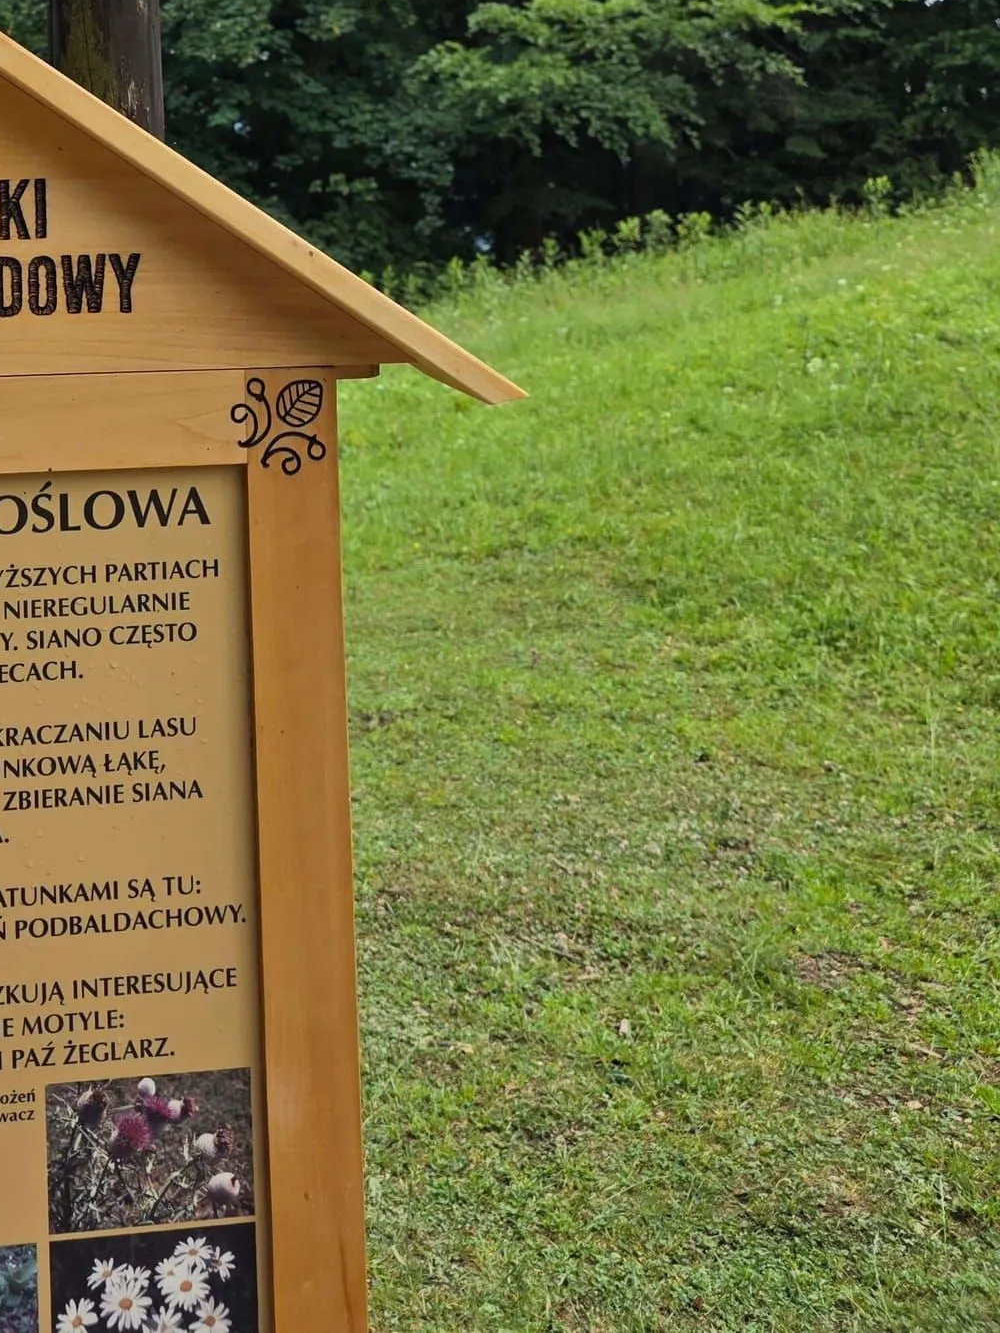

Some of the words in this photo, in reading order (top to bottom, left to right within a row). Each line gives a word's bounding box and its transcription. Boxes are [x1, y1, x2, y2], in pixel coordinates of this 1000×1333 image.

[105, 559, 218, 582] PARTIACH
[4, 592, 190, 619] NIEREGULARNIE
[27, 627, 102, 650] SIANO
[109, 622, 197, 648] CZĘSTO
[139, 717, 196, 738] LASU
[104, 750, 165, 775] ŁĄKĘ,
[3, 784, 124, 811] ZBIERANIE
[132, 780, 203, 803] SIANA
[128, 878, 155, 902] SĄ
[162, 875, 201, 895] TU:
[15, 904, 246, 939] PODBALDACHOWY.
[73, 968, 236, 999] INTERESUJĄCE
[22, 1010, 124, 1035] MOTYLE:
[12, 1047, 55, 1069] PAŹ
[63, 1037, 174, 1064] ŻEGLARZ.
